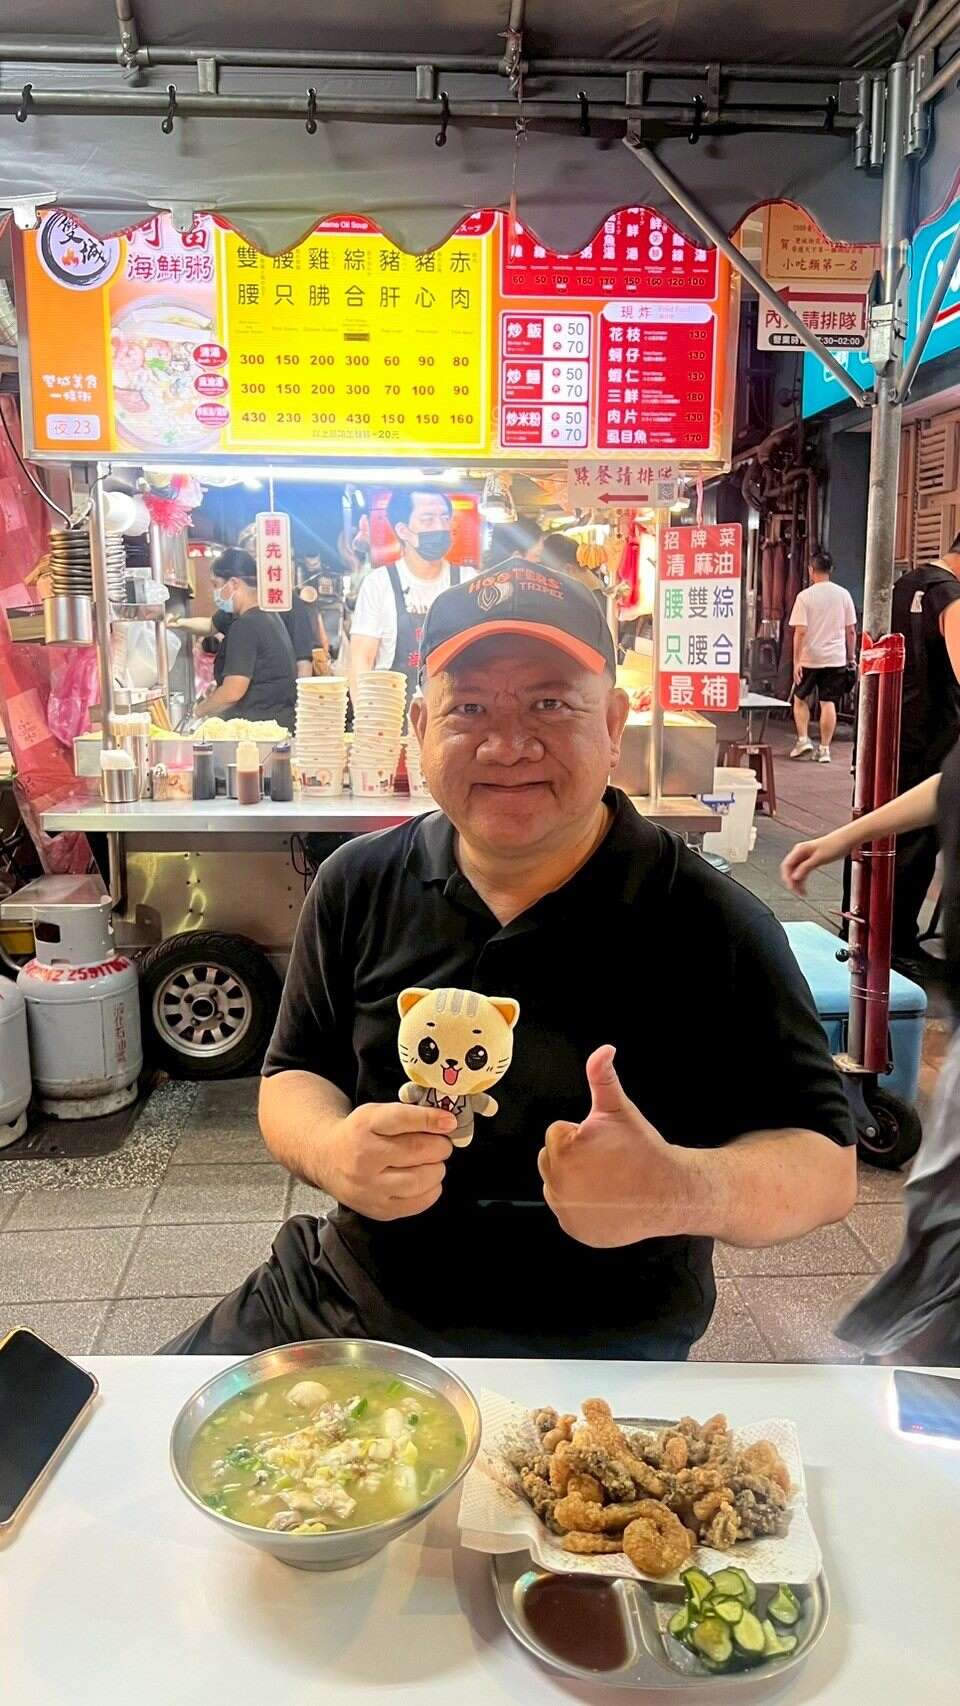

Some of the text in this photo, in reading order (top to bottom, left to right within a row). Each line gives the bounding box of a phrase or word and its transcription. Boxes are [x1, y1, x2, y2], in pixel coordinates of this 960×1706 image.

[128, 254, 212, 279] 海鮮粥
[782, 257, 857, 271] 小吃類第一名
[344, 248, 365, 307] 綜合
[379, 250, 401, 308] 豬肝
[450, 252, 471, 309] 赤肉
[620, 304, 652, 319] 現炸
[766, 309, 857, 330] 內請排隊
[507, 322, 542, 338] 炒飯
[568, 322, 584, 335] 50
[609, 327, 640, 342] 花枝
[568, 341, 584, 353] 70
[240, 354, 469, 367] 300 150 200 300 60 90 80
[567, 368, 582, 380] 50
[241, 384, 469, 395] 300 150 200 300 70 100 90
[567, 385, 582, 397] 70
[607, 388, 639, 404] 三鮮
[242, 412, 473, 424] 430 230 300 430 150 150 160
[506, 411, 541, 427] 炒米粉
[566, 412, 582, 424] 50
[607, 408, 638, 424] 肉片
[74, 420, 91, 434] 23
[565, 429, 581, 441] 70
[606, 429, 647, 444] 虱目魚
[574, 464, 672, 486] 點餐請排隊
[664, 528, 736, 550] 招牌菜
[265, 519, 284, 604] 請先付款
[665, 552, 734, 577] 清 麻油
[668, 675, 729, 708] 最補
